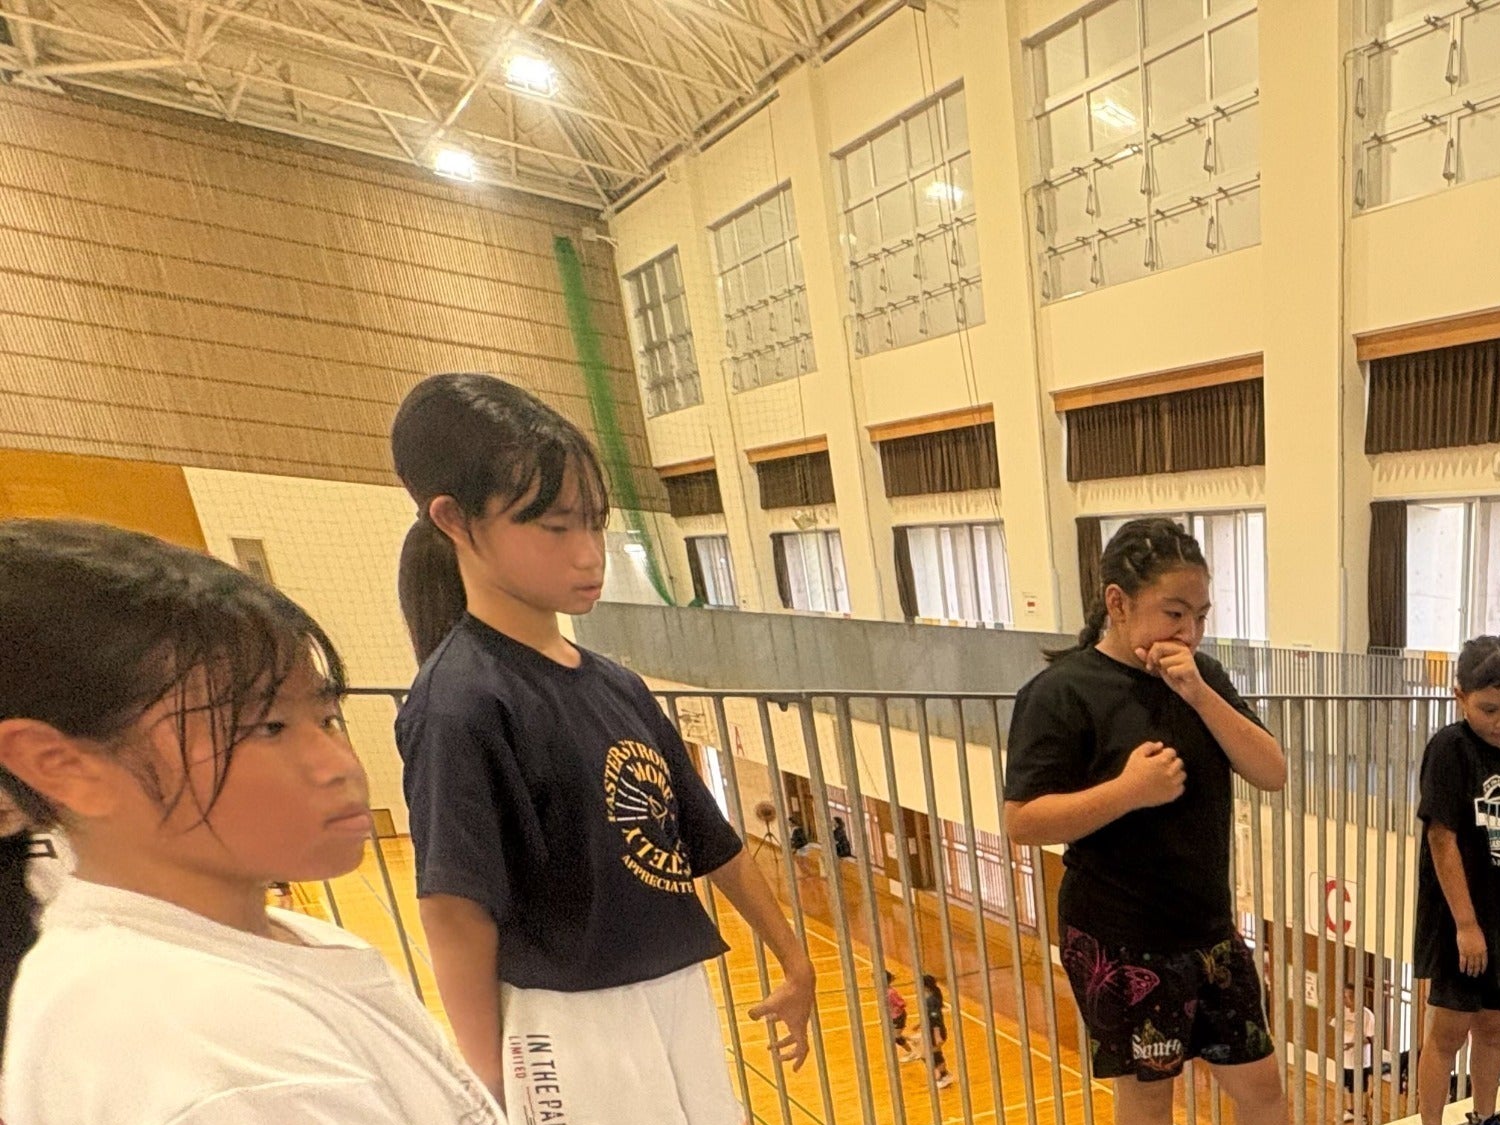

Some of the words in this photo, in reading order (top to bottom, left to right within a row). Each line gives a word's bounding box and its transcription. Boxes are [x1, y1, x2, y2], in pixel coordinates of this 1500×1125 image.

[621, 854, 694, 893] APPRECIATE
[508, 1035, 527, 1080] LIMITED
[526, 1034, 552, 1053] IN
[531, 1060, 560, 1094] THE
